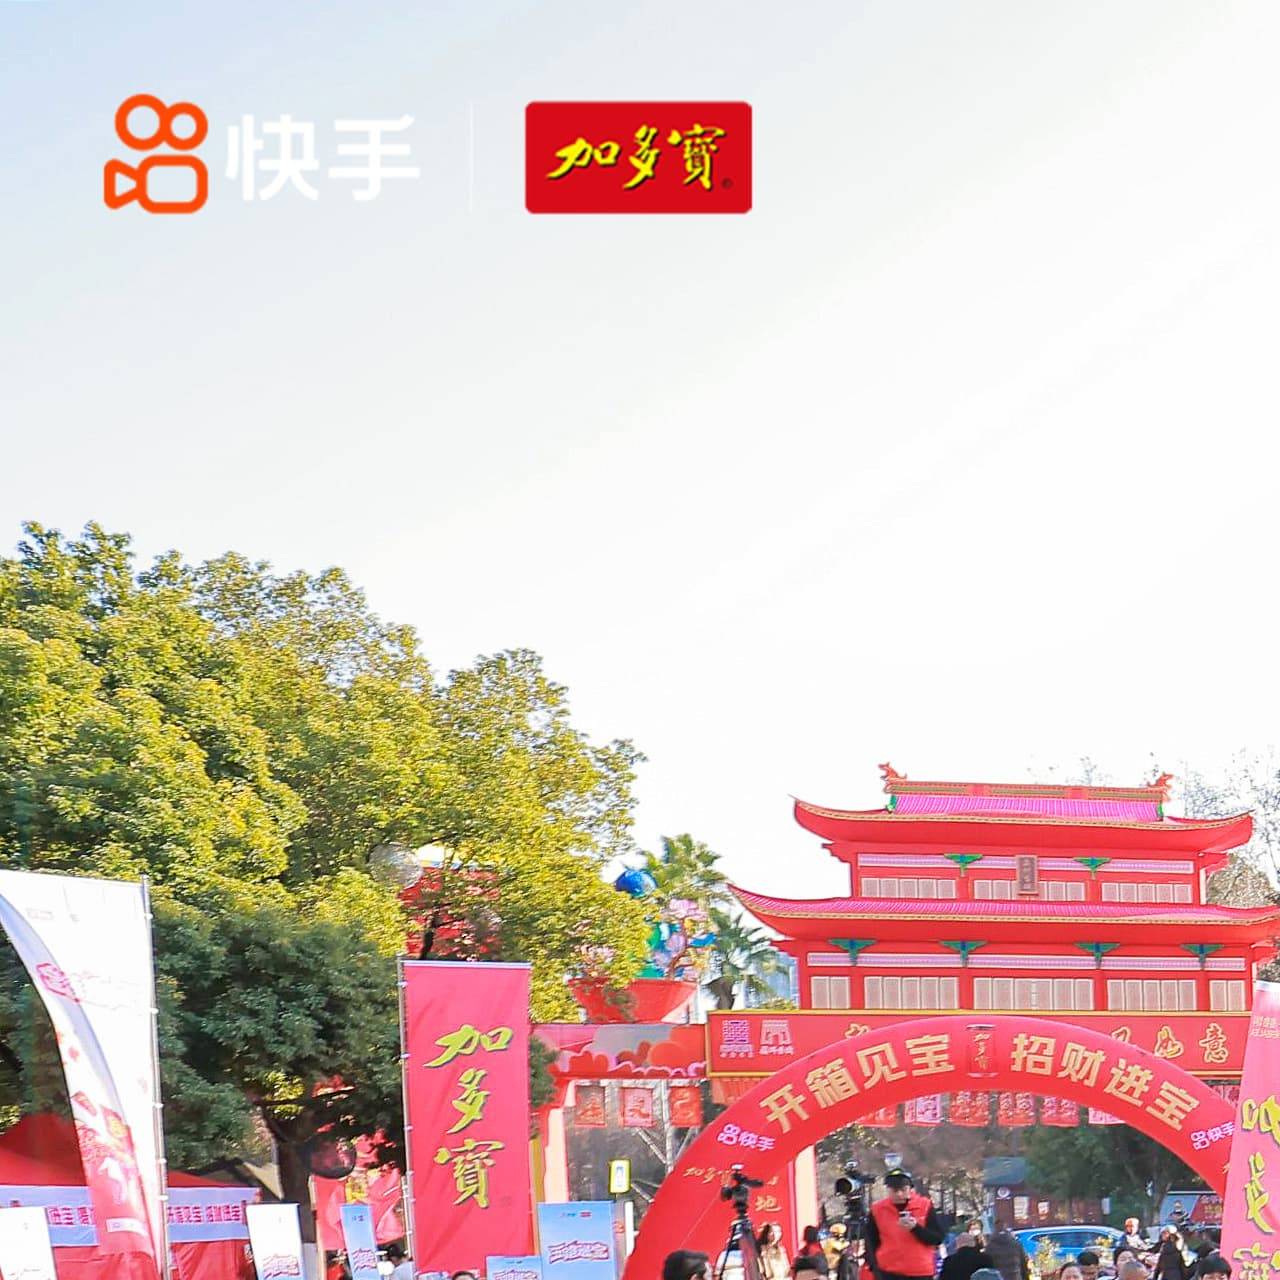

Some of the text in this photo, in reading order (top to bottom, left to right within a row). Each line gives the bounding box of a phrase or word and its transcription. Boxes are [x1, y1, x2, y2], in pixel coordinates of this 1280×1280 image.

[424, 1023, 514, 1208] 加多寶
[760, 1034, 954, 1134] 开箱见宝
[1010, 1033, 1199, 1131] 招财进宝
